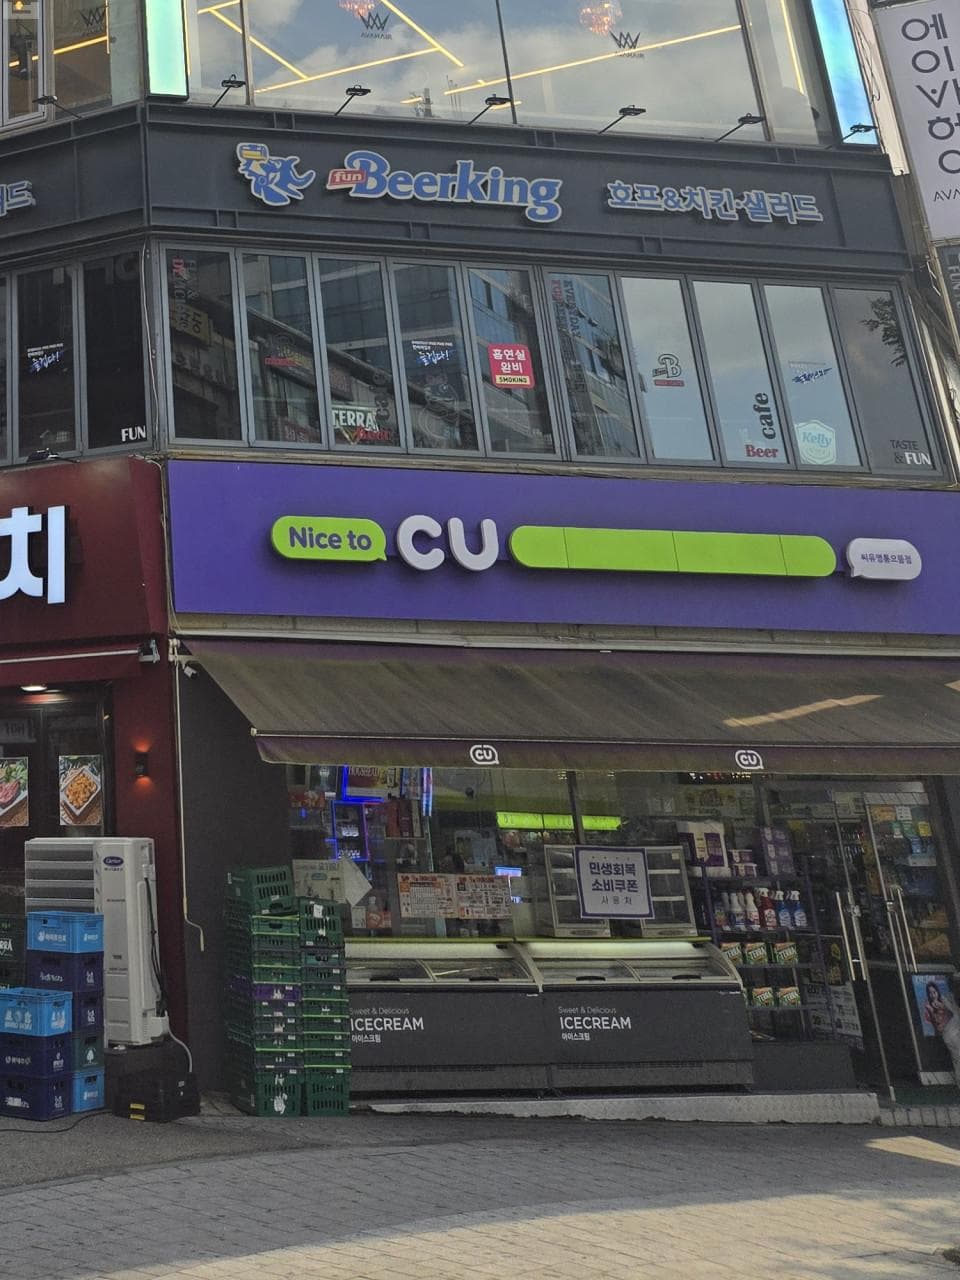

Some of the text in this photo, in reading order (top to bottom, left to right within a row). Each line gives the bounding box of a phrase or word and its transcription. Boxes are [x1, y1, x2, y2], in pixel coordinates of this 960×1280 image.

[331, 148, 563, 223] fun Beerking
[492, 348, 526, 362] 흡연실
[501, 361, 524, 374] 완비
[498, 375, 528, 385] SMOKING
[332, 407, 379, 431] TERRA
[762, 392, 778, 440] cafe
[121, 425, 147, 443] FUN
[801, 429, 833, 448] Kelly
[745, 443, 779, 459] Beer
[890, 438, 920, 450] TASTE
[288, 527, 372, 551] Nice to
[397, 515, 499, 571] CU
[474, 747, 494, 762] CU
[738, 752, 759, 767] CU
[588, 861, 637, 876] 민생회복
[591, 878, 639, 893] 소비쿠폰
[378, 1006, 410, 1015] Delicious
[558, 1006, 617, 1015] Sweet Delicious
[350, 1017, 425, 1032] ICECREAM
[559, 1016, 632, 1031] ICECREAM
[351, 1033, 381, 1042] 아이스크림
[561, 1032, 591, 1041] 아이스크림
